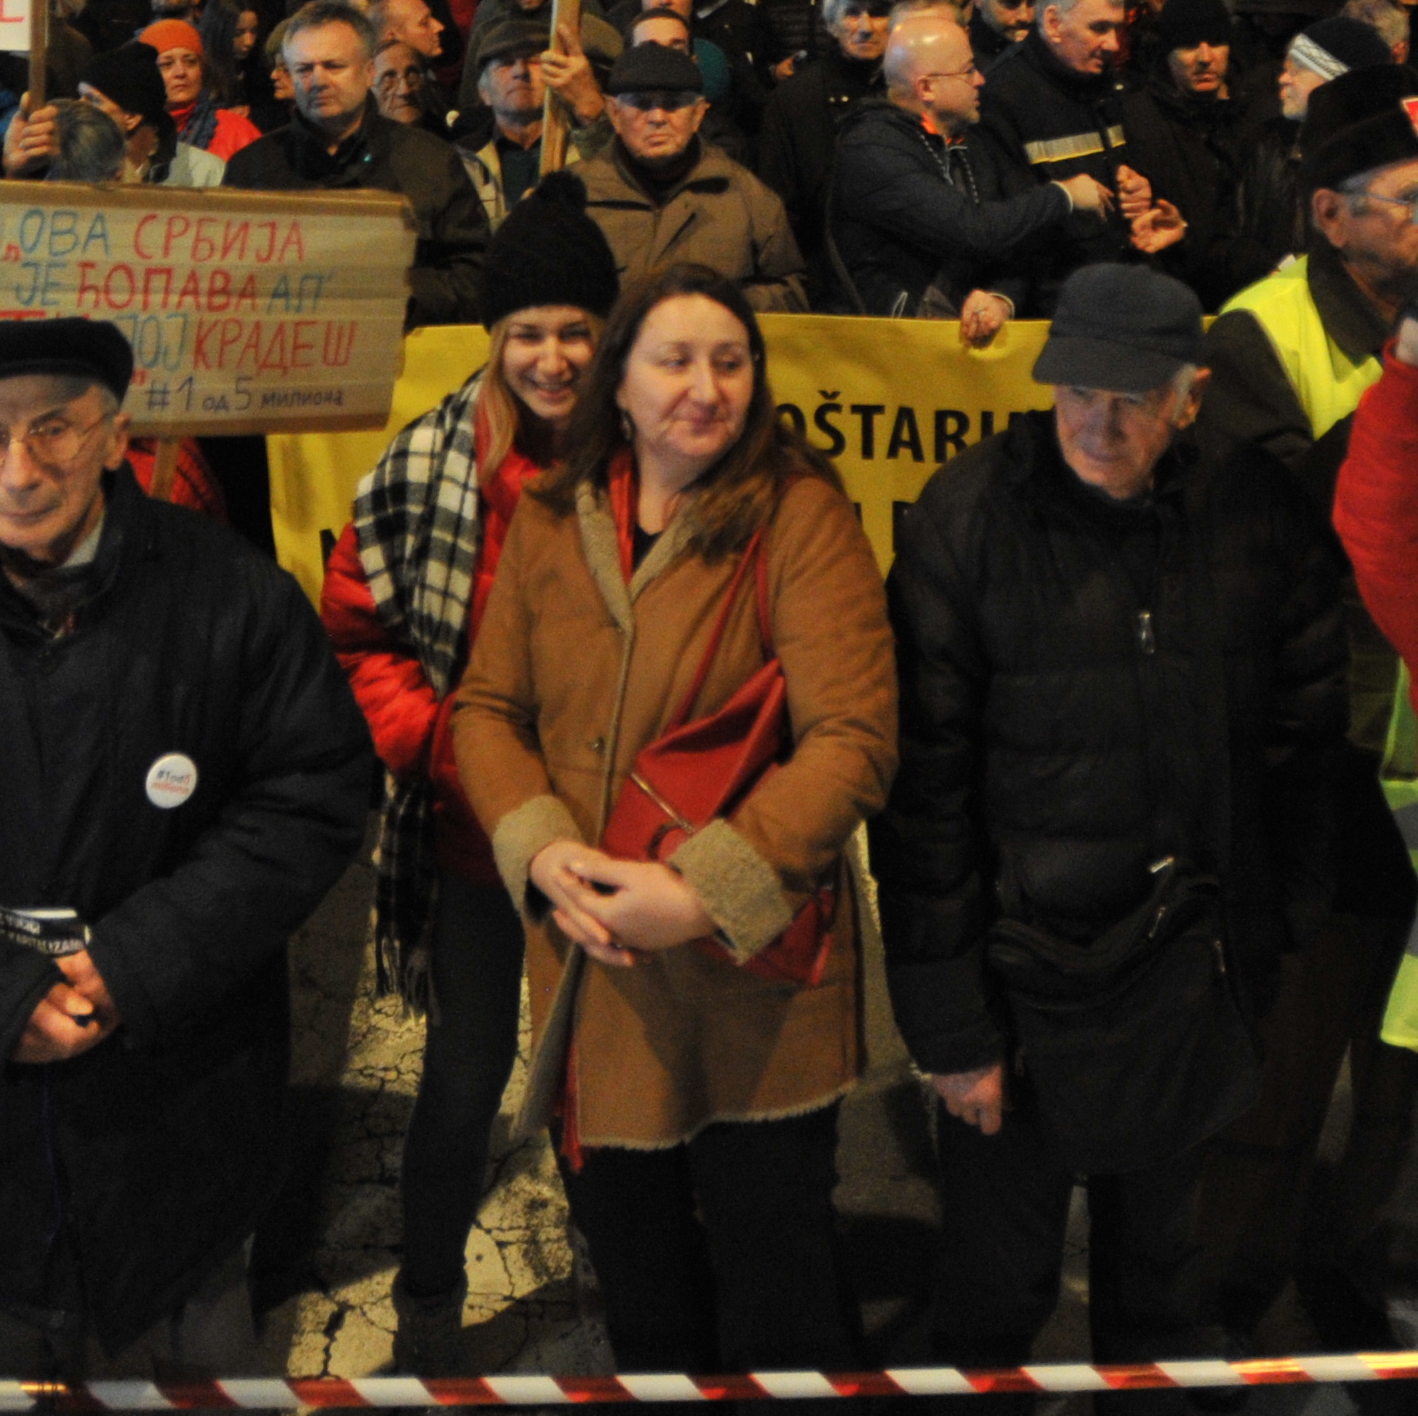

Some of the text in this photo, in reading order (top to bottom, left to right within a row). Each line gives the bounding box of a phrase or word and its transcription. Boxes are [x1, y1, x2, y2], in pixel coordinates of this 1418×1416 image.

[132, 213, 306, 264] СРБИЈА
[15, 261, 68, 308] ЈЕ
[76, 261, 258, 314] ЋОПАВА
[192, 314, 357, 377] КРАДЕШ
